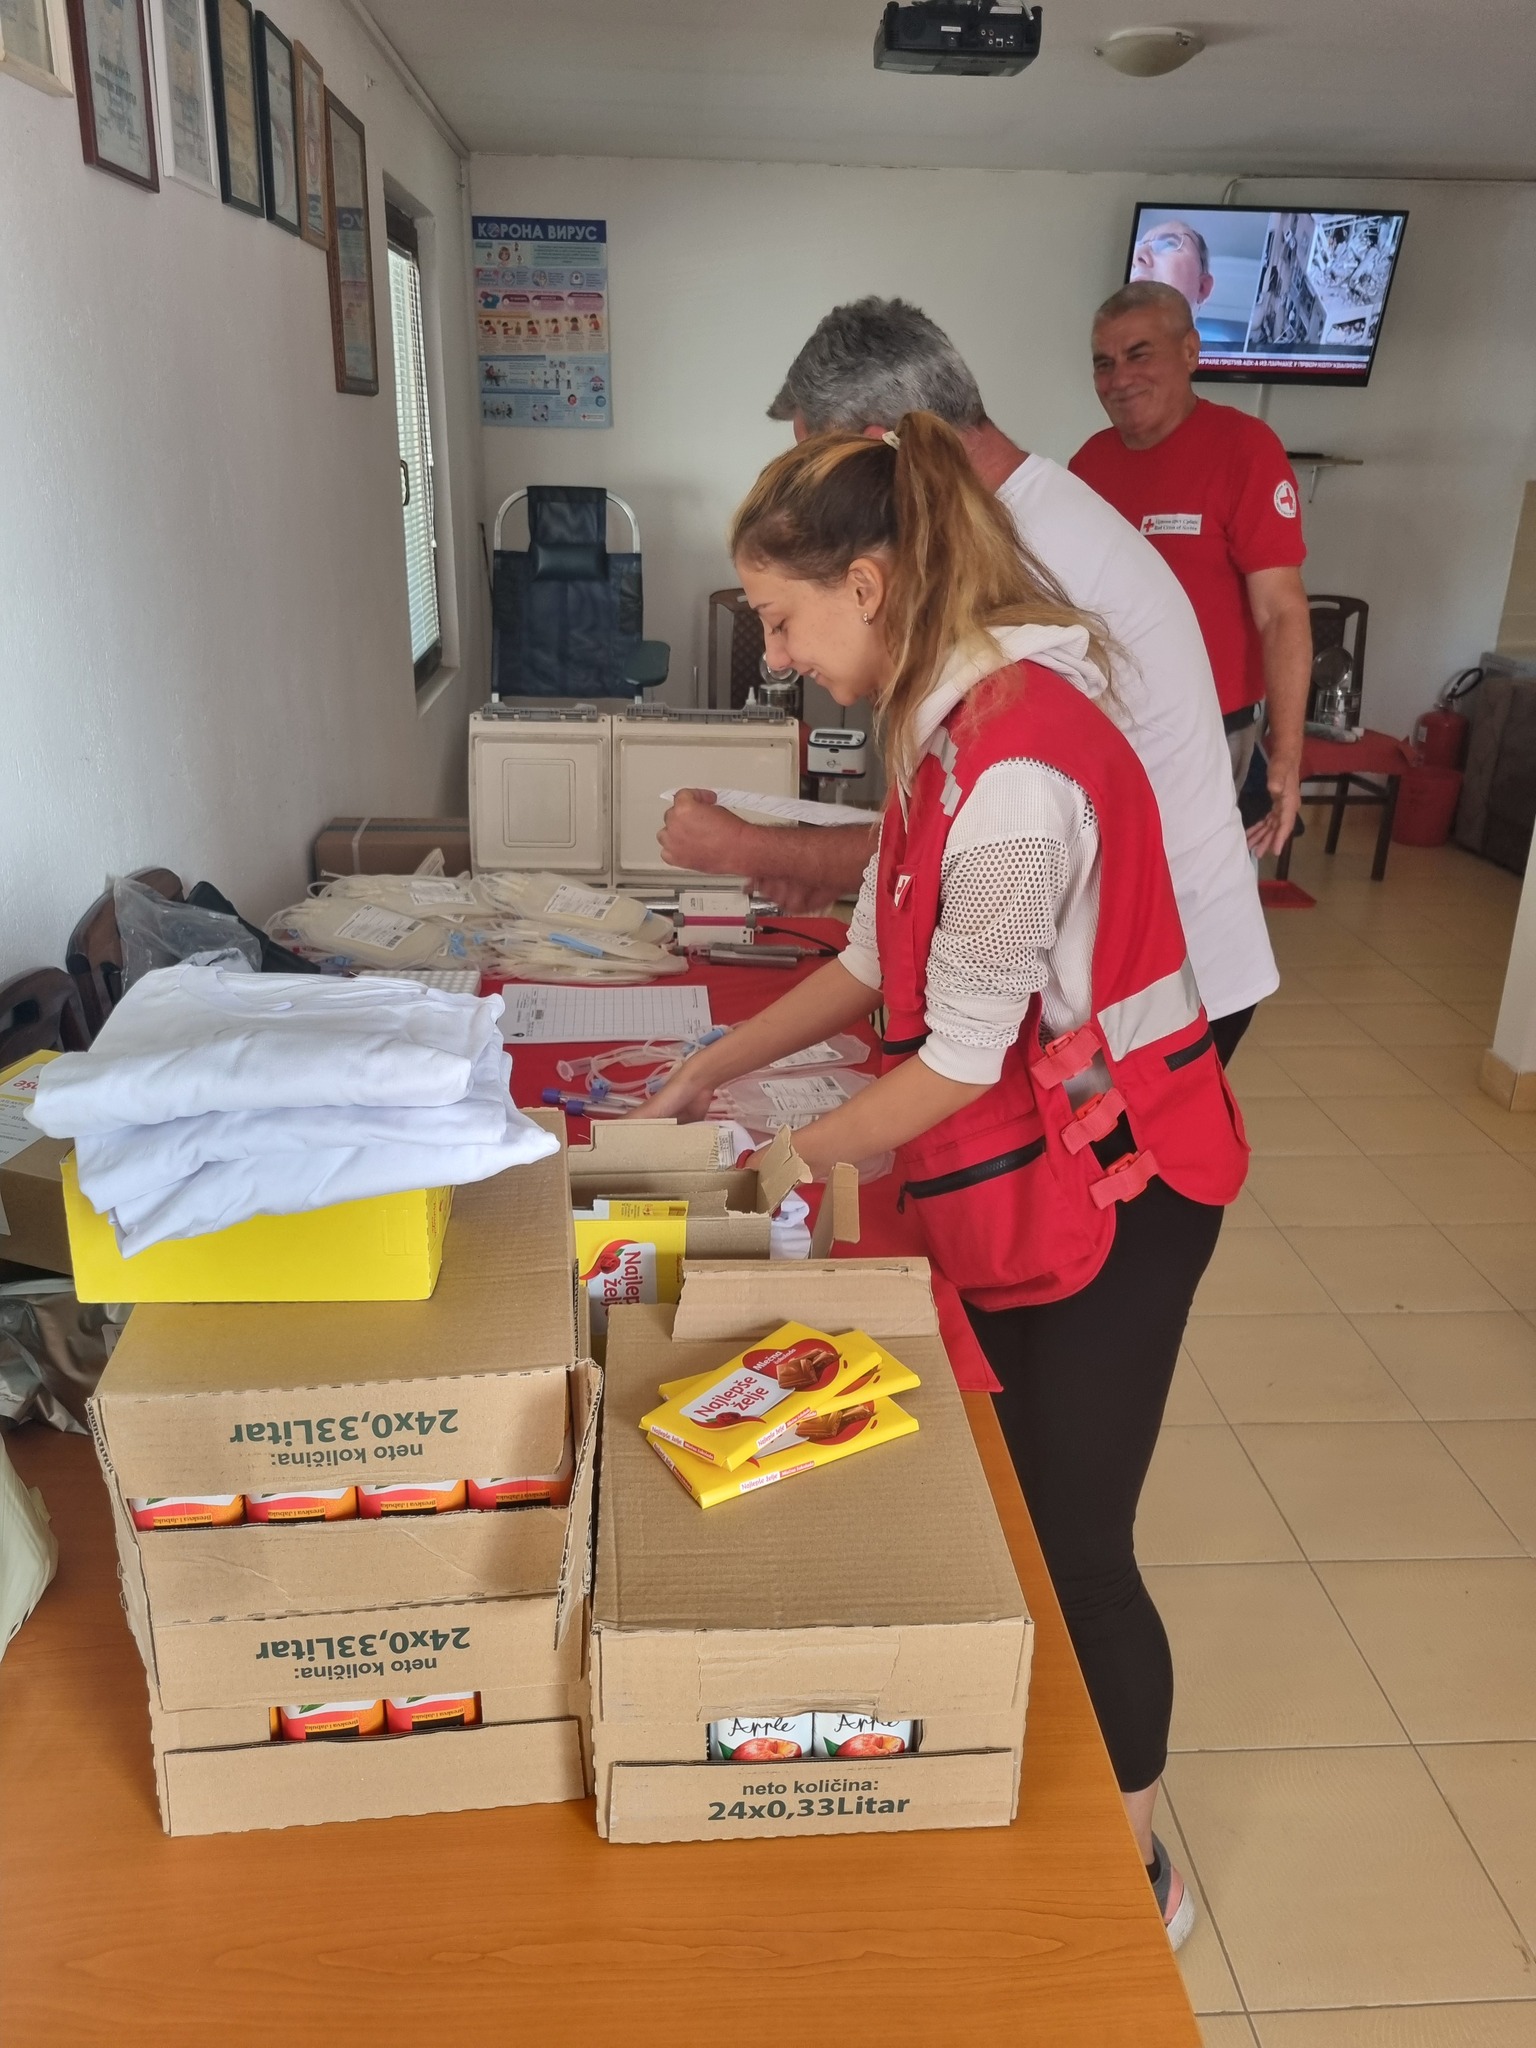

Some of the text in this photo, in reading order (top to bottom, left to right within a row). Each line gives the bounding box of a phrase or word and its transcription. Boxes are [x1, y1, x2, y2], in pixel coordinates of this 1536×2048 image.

[547, 224, 598, 241] ВИРУС
[620, 1250, 644, 1305] Najlep
[752, 1350, 783, 1371] Mlečna
[693, 1376, 758, 1418] Najlepše
[730, 1387, 770, 1411] želje
[229, 1408, 459, 1448] 24x0,33Litar
[270, 1443, 424, 1468] neto količina:
[255, 1626, 471, 1663] 24x0,33Litar
[294, 1657, 438, 1680] neto količina:
[728, 1717, 797, 1737] Apple
[742, 1778, 879, 1796] neto količina:
[707, 1795, 911, 1821] 24x0,33Litar
